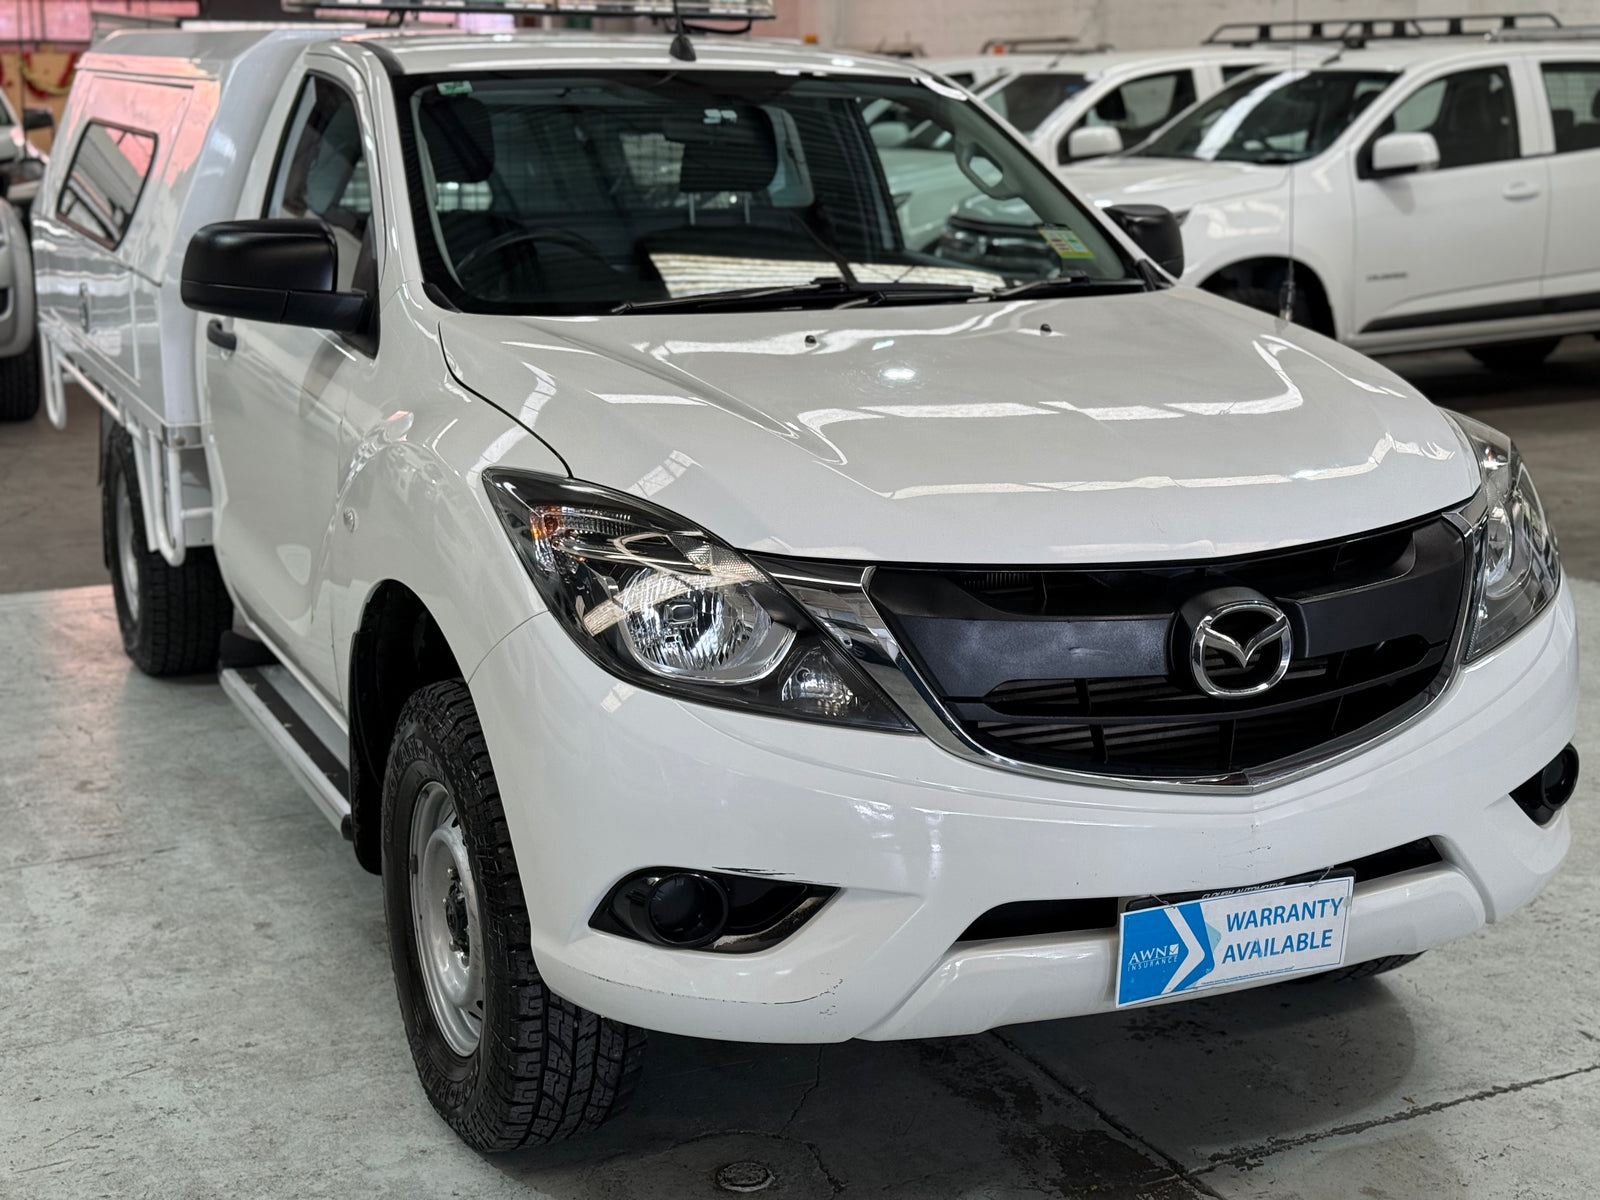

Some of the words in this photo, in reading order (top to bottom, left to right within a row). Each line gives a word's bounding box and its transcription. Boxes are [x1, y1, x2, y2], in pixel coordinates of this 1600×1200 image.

[1226, 897, 1344, 932] WARRANTY
[1128, 945, 1168, 965] AWN
[1221, 928, 1333, 964] AVAILABLE
[1127, 955, 1178, 972] INSURANCE
